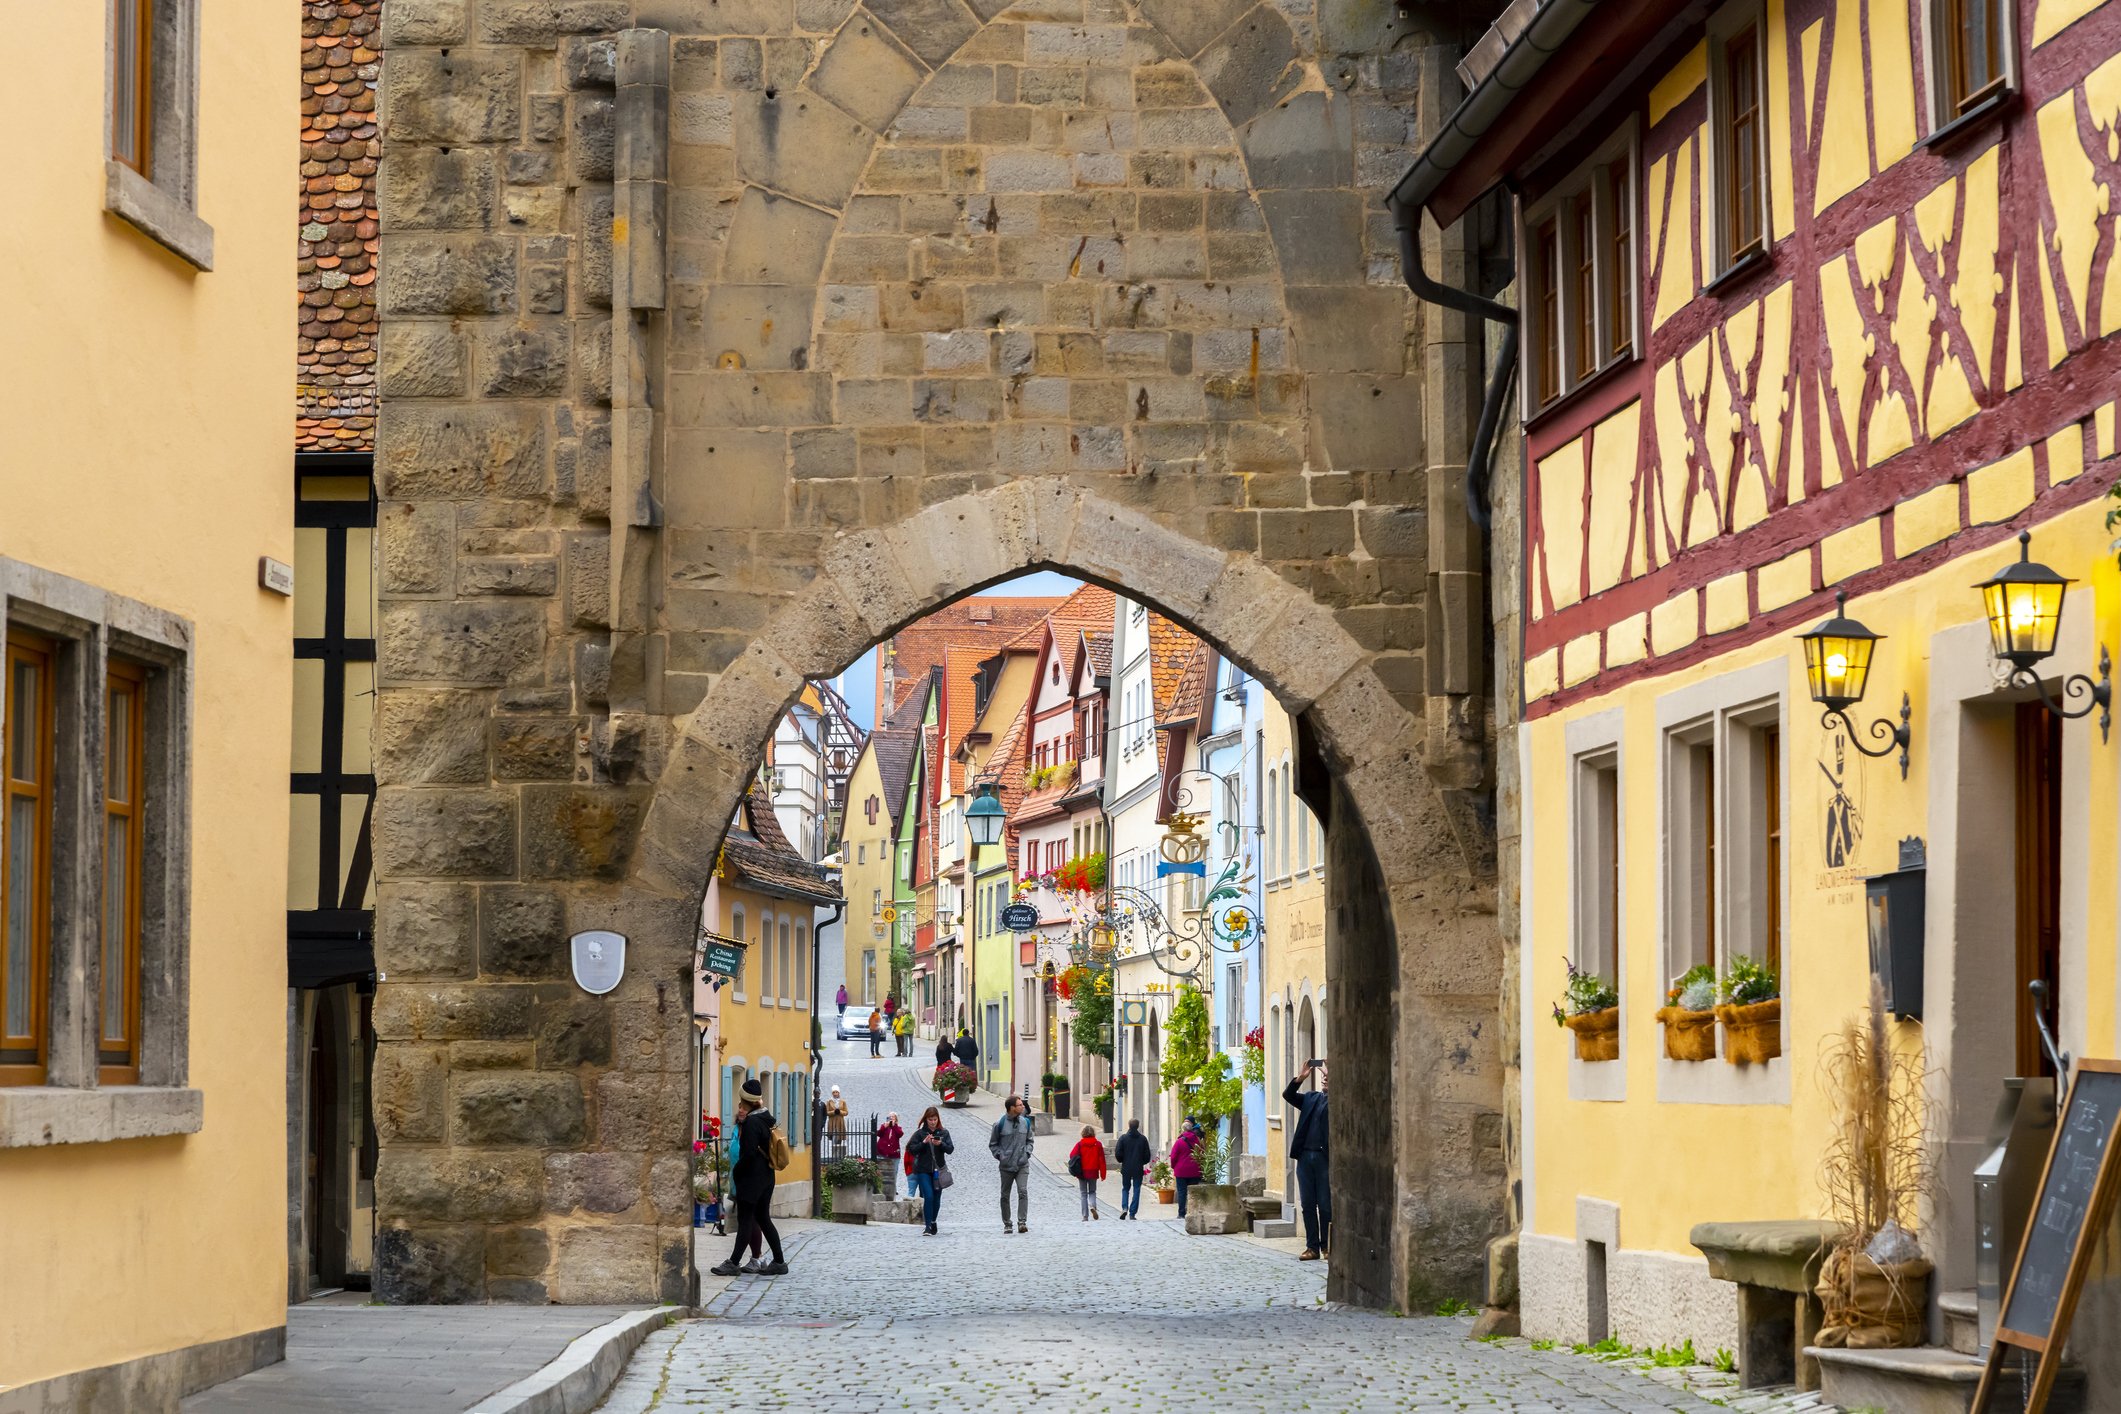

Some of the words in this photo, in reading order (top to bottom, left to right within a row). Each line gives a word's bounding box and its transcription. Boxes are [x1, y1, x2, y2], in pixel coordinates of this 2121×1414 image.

[1008, 914, 1032, 922] Hirsch
[715, 948, 732, 957] China
[710, 960, 731, 972] Peking
